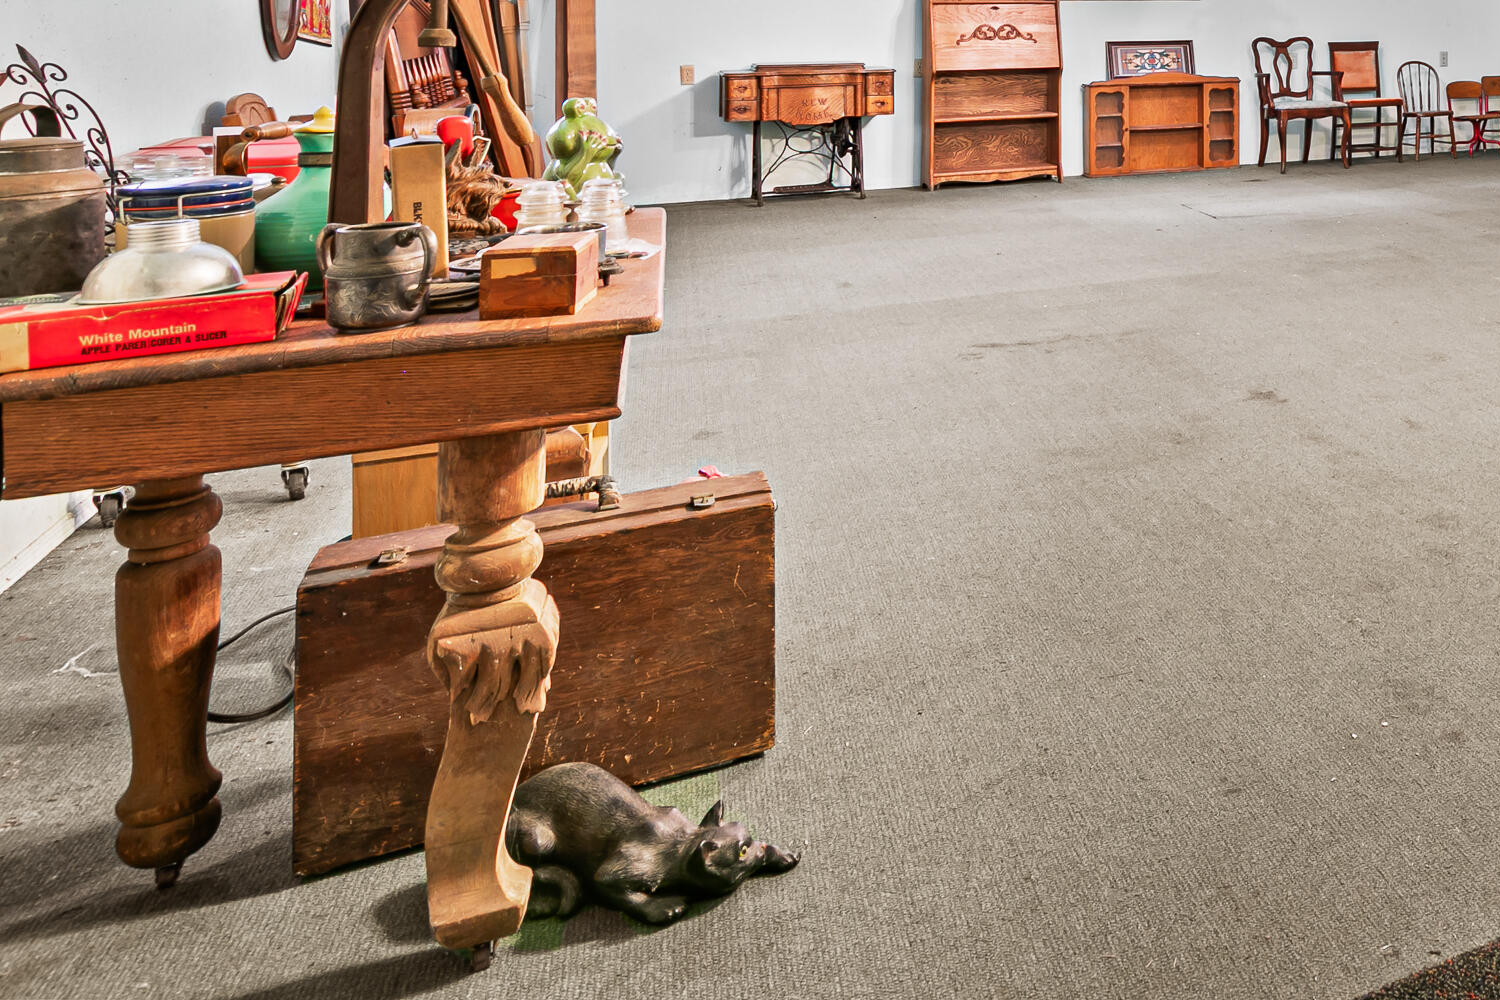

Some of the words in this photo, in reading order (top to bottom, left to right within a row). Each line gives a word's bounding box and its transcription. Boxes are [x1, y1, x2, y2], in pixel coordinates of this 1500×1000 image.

[79, 332, 123, 346] White
[128, 322, 197, 340] Mountain
[80, 346, 111, 356] APPLE
[115, 340, 147, 351] PARER
[150, 336, 182, 347] CORER
[184, 334, 192, 344] &
[195, 330, 227, 342] SLICER
